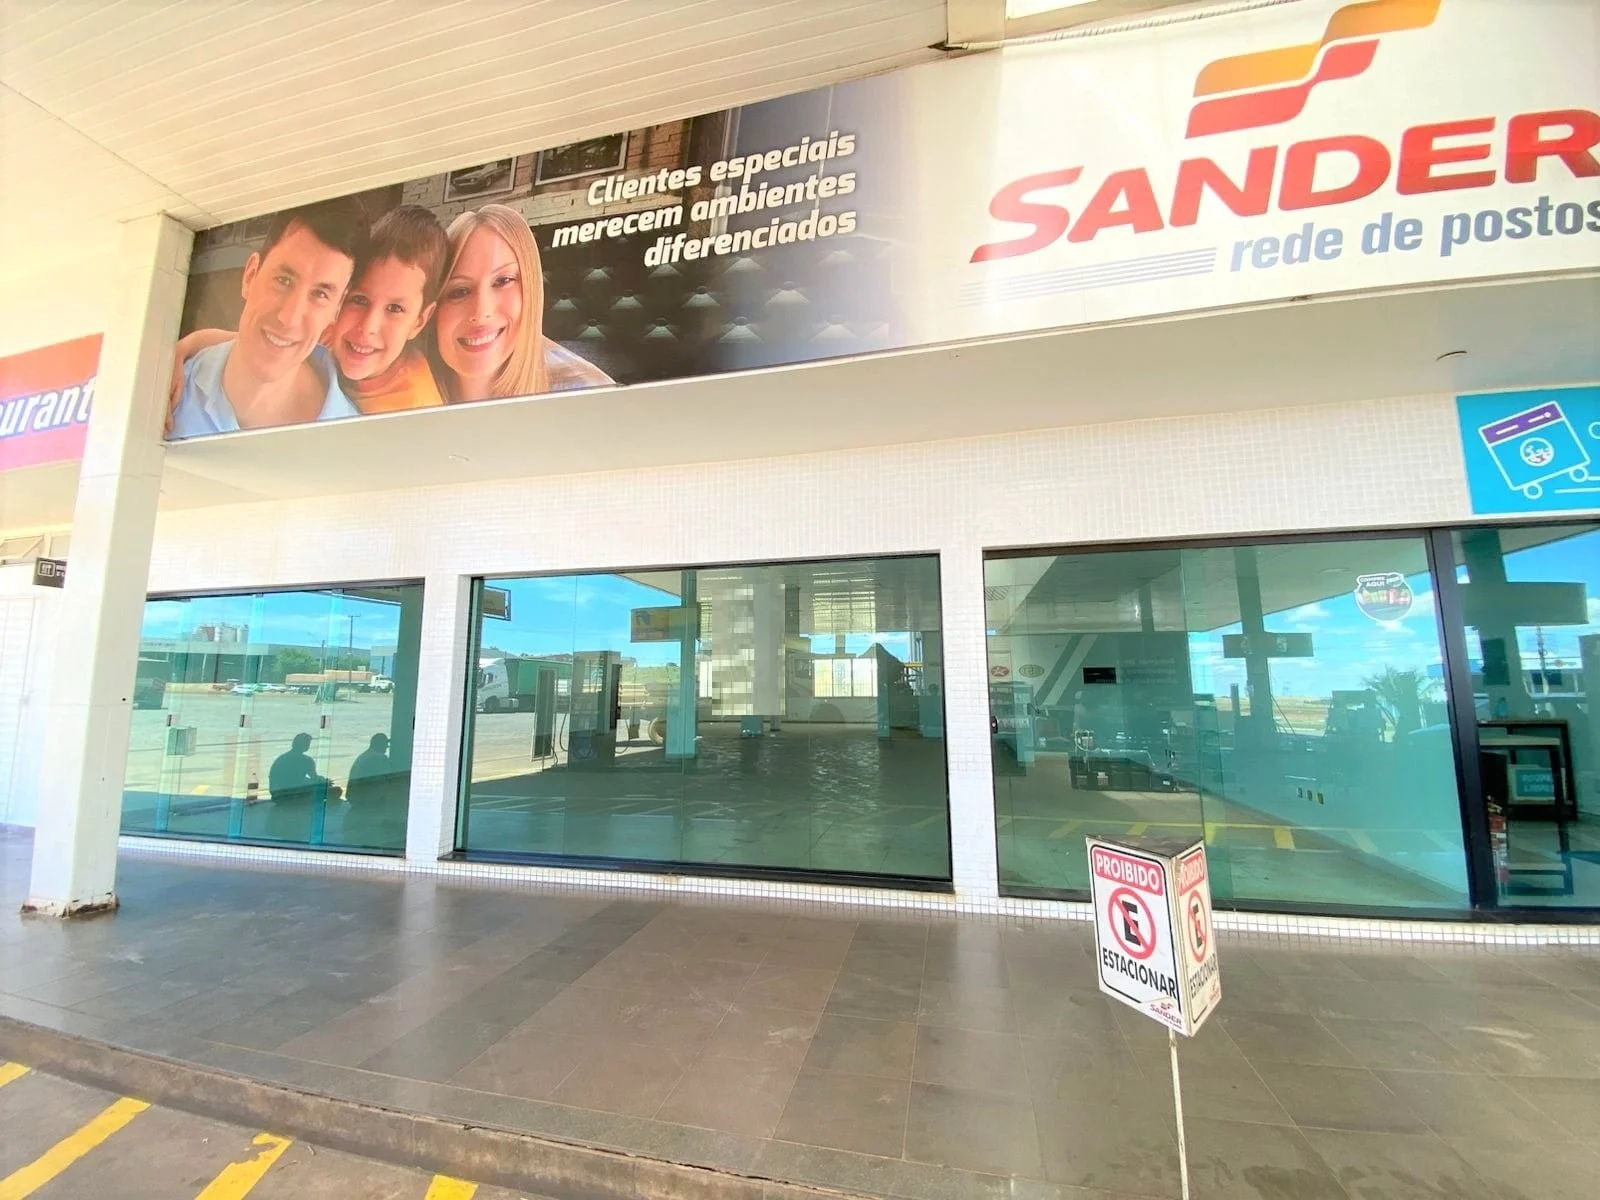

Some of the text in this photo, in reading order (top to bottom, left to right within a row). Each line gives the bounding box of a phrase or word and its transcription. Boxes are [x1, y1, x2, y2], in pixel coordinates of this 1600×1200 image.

[587, 130, 857, 206] Clientes especiais
[969, 108, 1600, 264] SANDER
[551, 171, 857, 248] merecem ambientes
[643, 208, 857, 268] diferenciados
[1229, 195, 1600, 273] rede de postos
[0, 375, 98, 438] urant
[1095, 852, 1161, 893] PROIBIDO
[1102, 946, 1177, 1000] ESTACIONAR
[1149, 1003, 1182, 1025] SANDER
